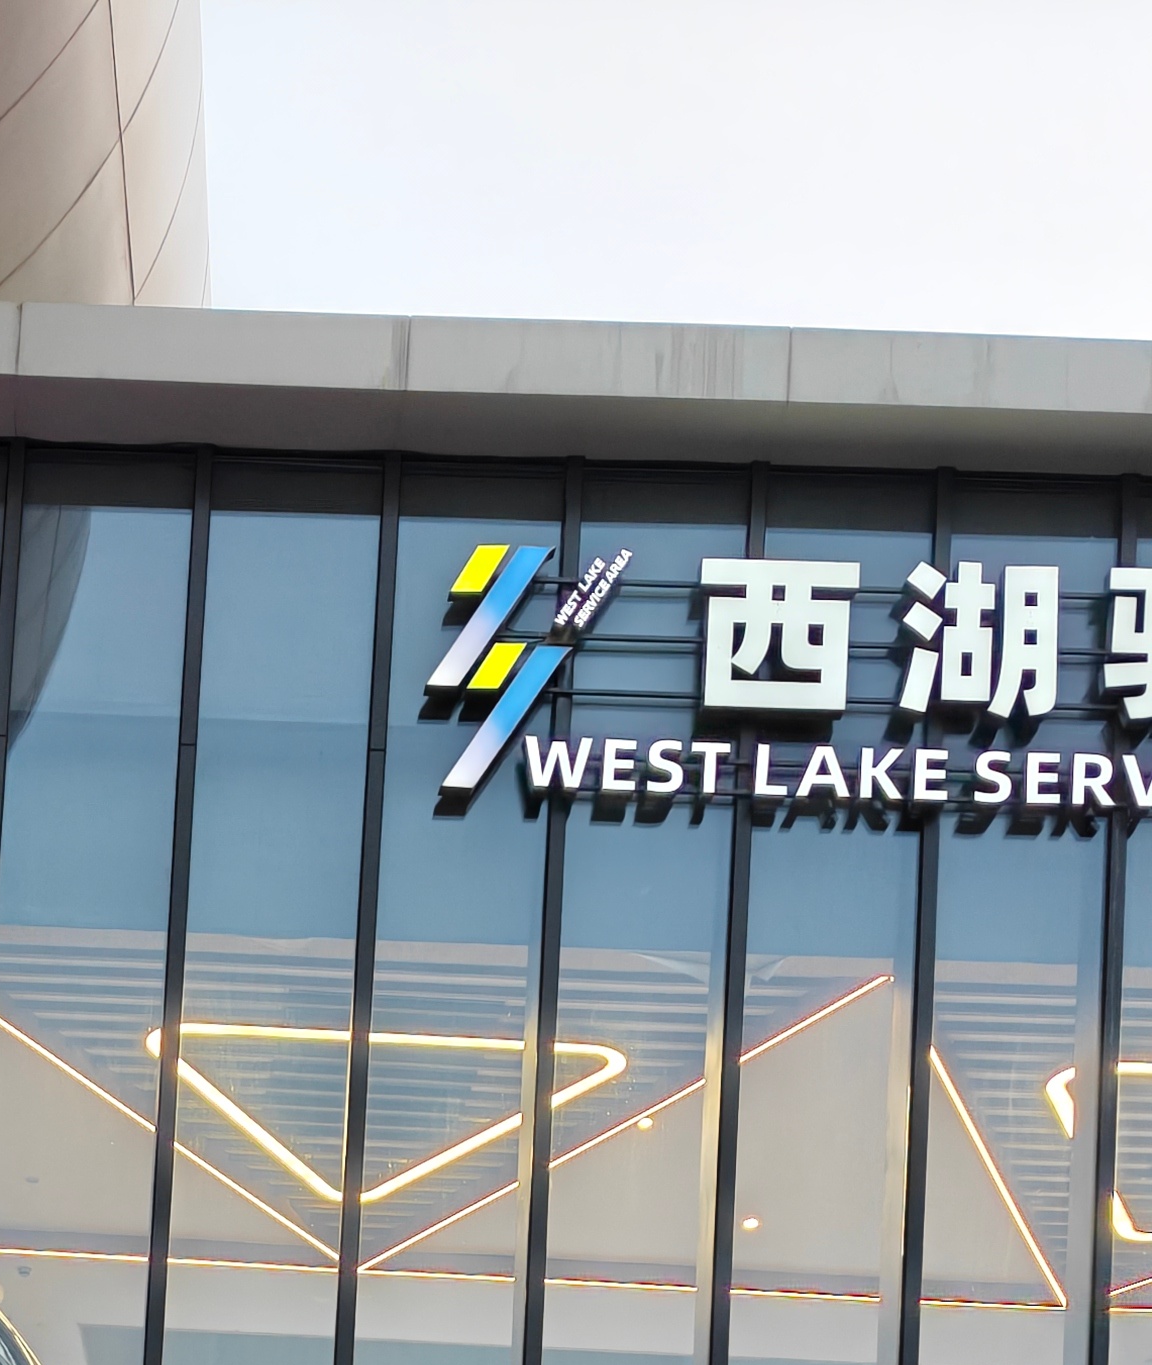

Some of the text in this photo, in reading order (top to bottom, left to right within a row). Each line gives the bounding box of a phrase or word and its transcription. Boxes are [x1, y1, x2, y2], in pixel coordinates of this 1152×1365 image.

[554, 557, 606, 626] WEST LAKE
[573, 548, 633, 628] SERVICE AREA
[525, 735, 731, 793] WEST
[754, 743, 949, 801] LAKE
